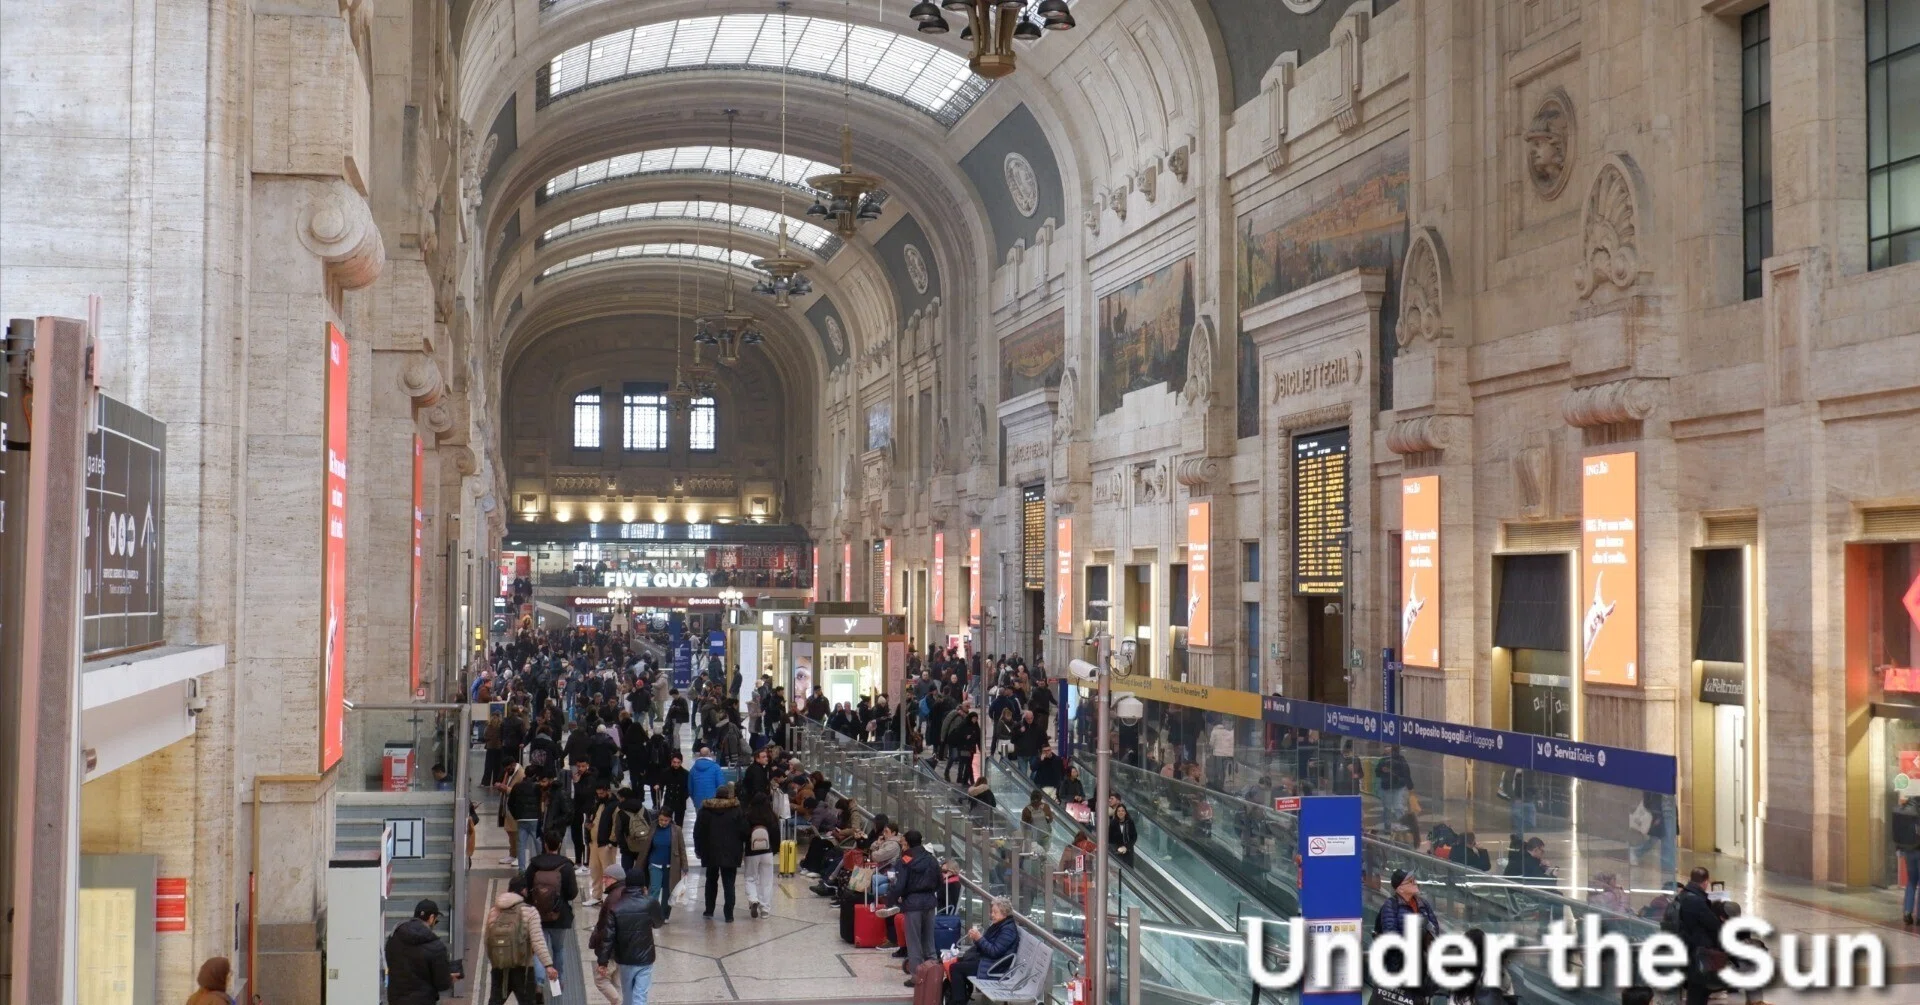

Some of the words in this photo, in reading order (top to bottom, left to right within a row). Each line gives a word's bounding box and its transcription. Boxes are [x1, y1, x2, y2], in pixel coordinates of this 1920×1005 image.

[1279, 357, 1349, 397] BIGLIETTERIA
[87, 454, 106, 477] gates
[604, 572, 648, 587] FIVE
[653, 572, 709, 588] GUYS
[1273, 700, 1285, 712] Metro
[1338, 712, 1355, 724] Terminal
[1415, 723, 1440, 738] Deposito
[1441, 727, 1464, 744] Bagagli
[1473, 732, 1495, 749] Luggage
[1554, 744, 1576, 761] Servizi
[1576, 748, 1595, 763] Toilets
[1377, 988, 1397, 1000] TOTE
[1398, 996, 1414, 1005] BAG
